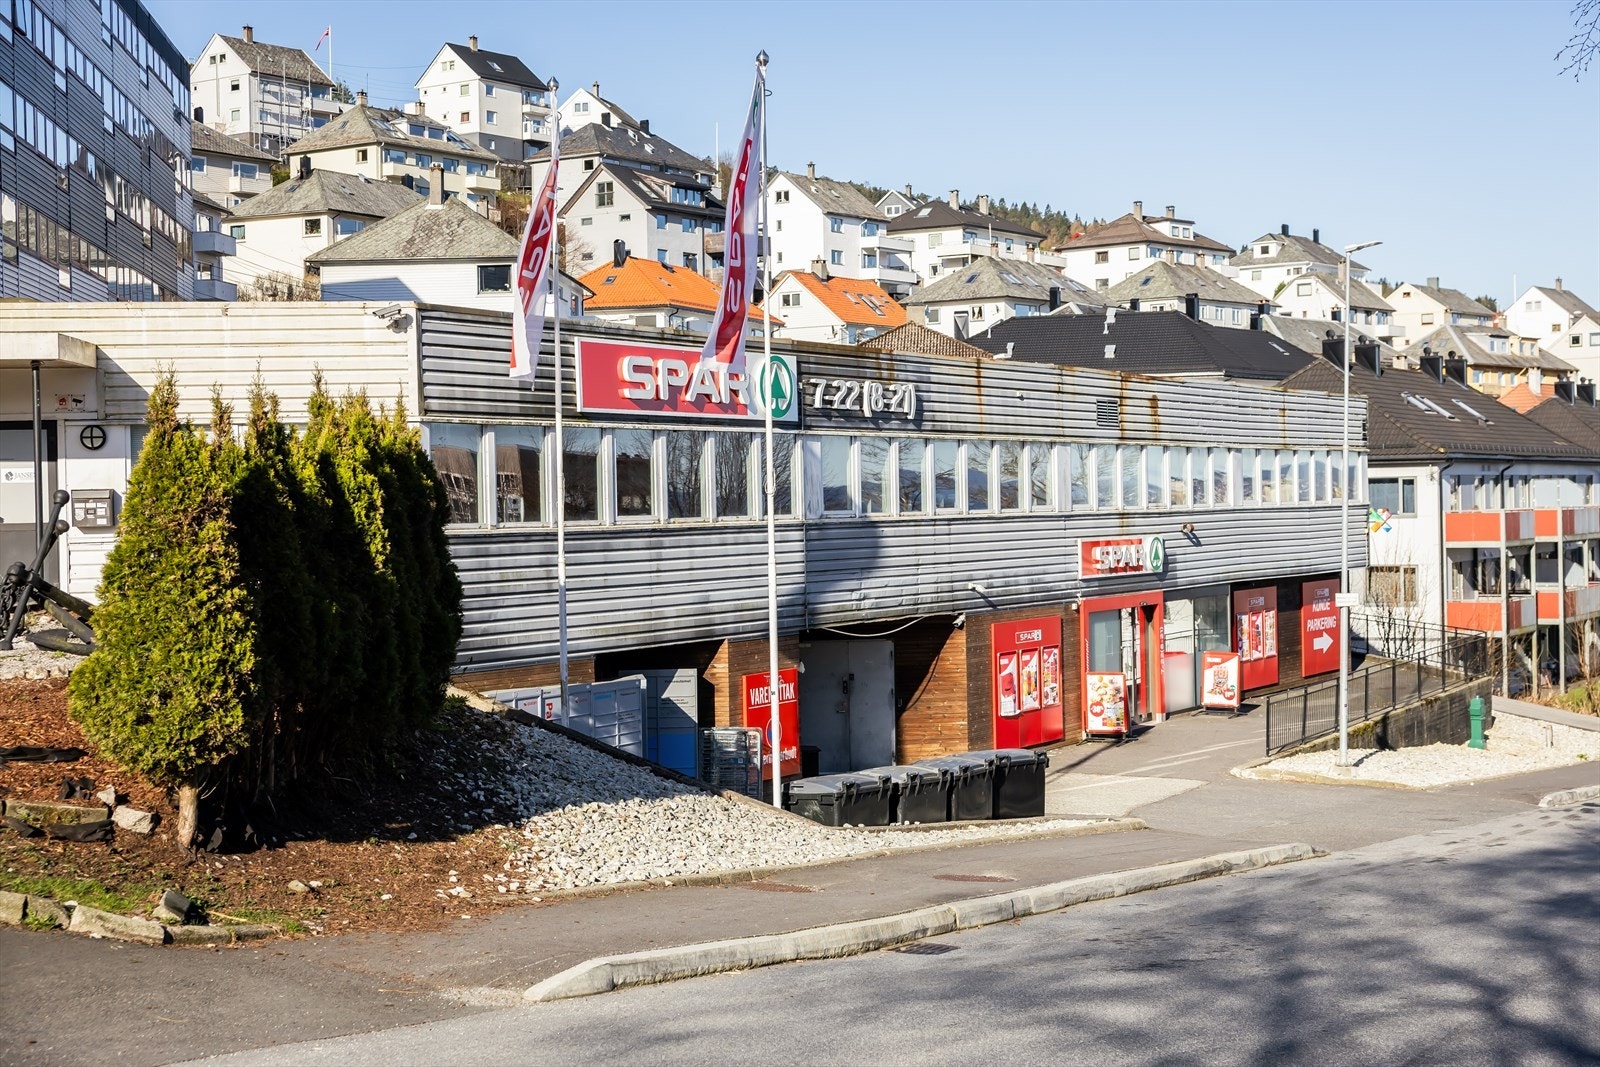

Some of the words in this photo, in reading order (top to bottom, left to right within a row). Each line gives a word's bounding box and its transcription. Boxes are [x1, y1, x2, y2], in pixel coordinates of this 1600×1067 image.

[620, 355, 749, 405] SPAR
[1093, 545, 1146, 570] SPAR
[1312, 598, 1331, 612] KUNDE
[1306, 615, 1337, 632] PARKERING
[1020, 632, 1035, 641] SPAR
[750, 682, 795, 706] VARETTAK
